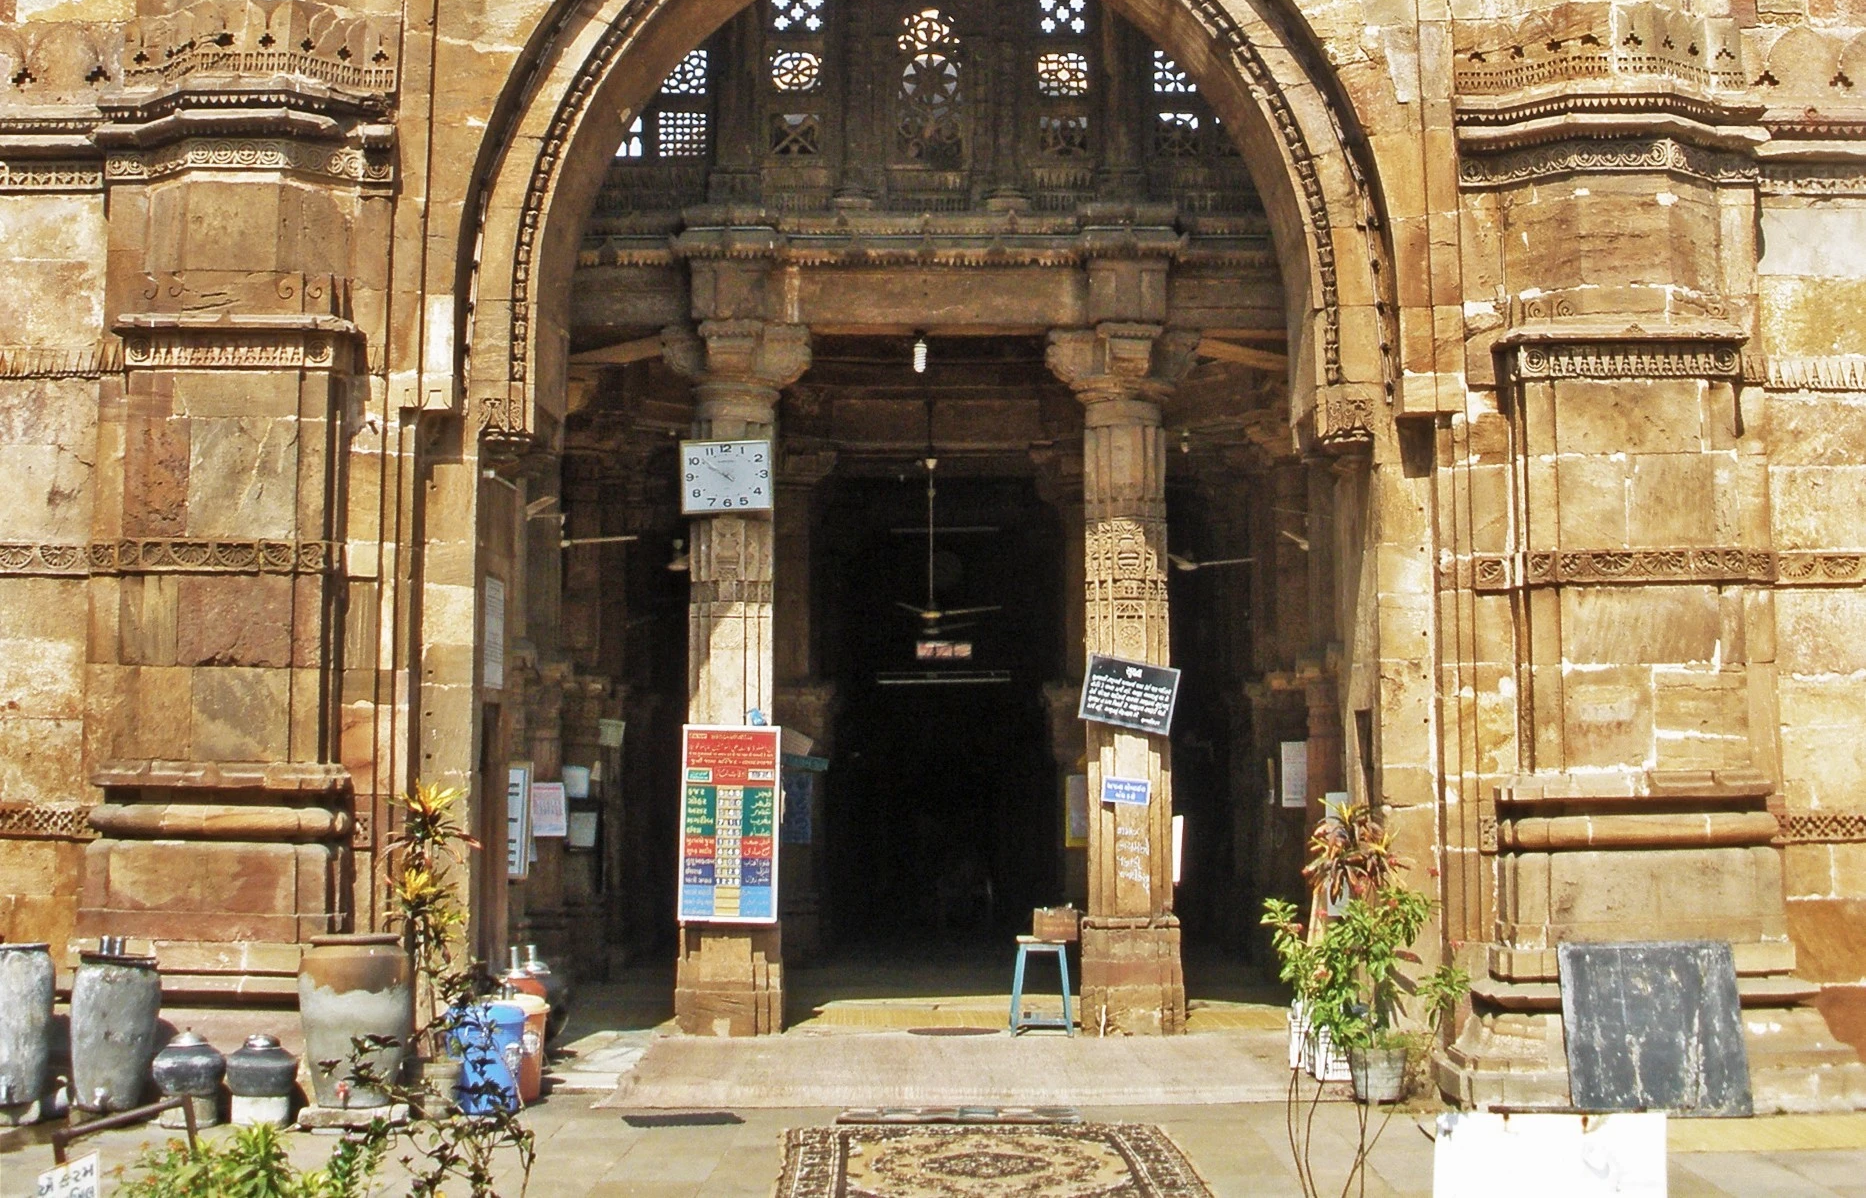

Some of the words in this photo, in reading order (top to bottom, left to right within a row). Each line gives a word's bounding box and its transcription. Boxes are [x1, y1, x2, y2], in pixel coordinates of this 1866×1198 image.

[706, 447, 714, 456] 11
[720, 444, 732, 453] 12
[740, 446, 744, 454] 1
[689, 457, 700, 466] 10
[754, 453, 763, 463] 2
[686, 473, 694, 482] 9
[760, 469, 768, 479] 3
[692, 489, 701, 498] 8
[753, 487, 762, 495] 4
[707, 497, 716, 506] 7
[723, 498, 732, 507] 6
[740, 497, 749, 506] 5
